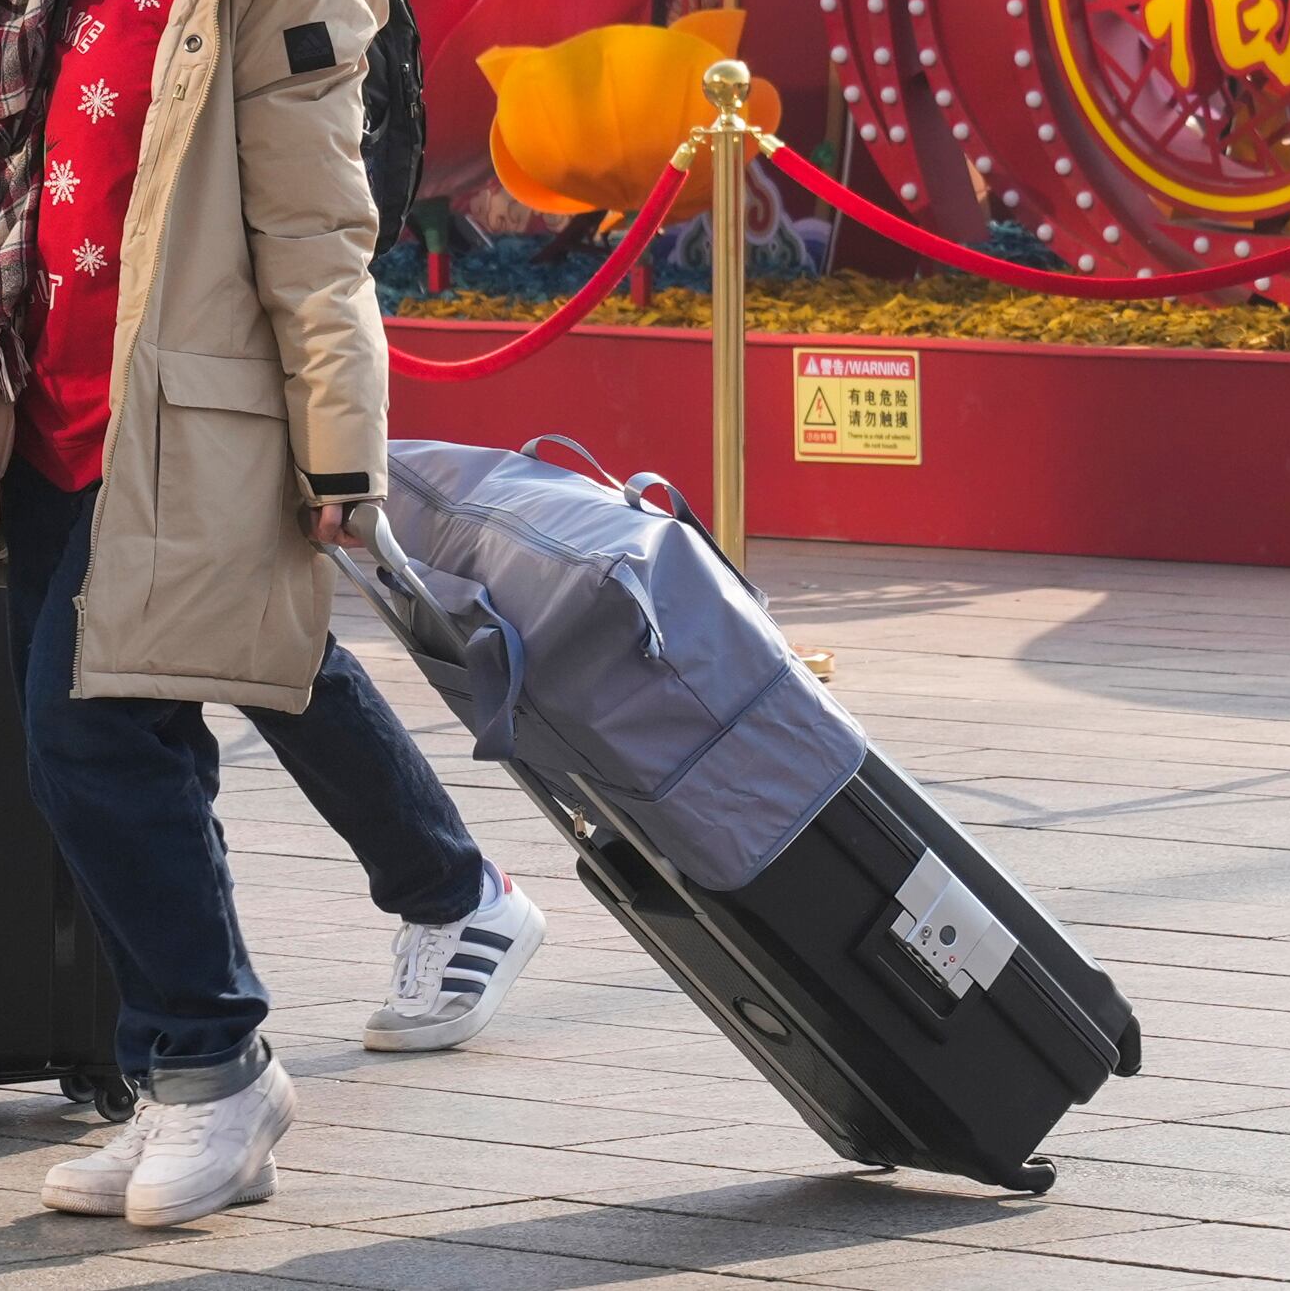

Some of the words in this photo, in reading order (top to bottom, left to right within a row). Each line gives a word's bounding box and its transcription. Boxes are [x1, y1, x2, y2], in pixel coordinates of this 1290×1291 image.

[848, 388, 909, 407] 有电危险
[848, 410, 909, 428] 请勿触摸
